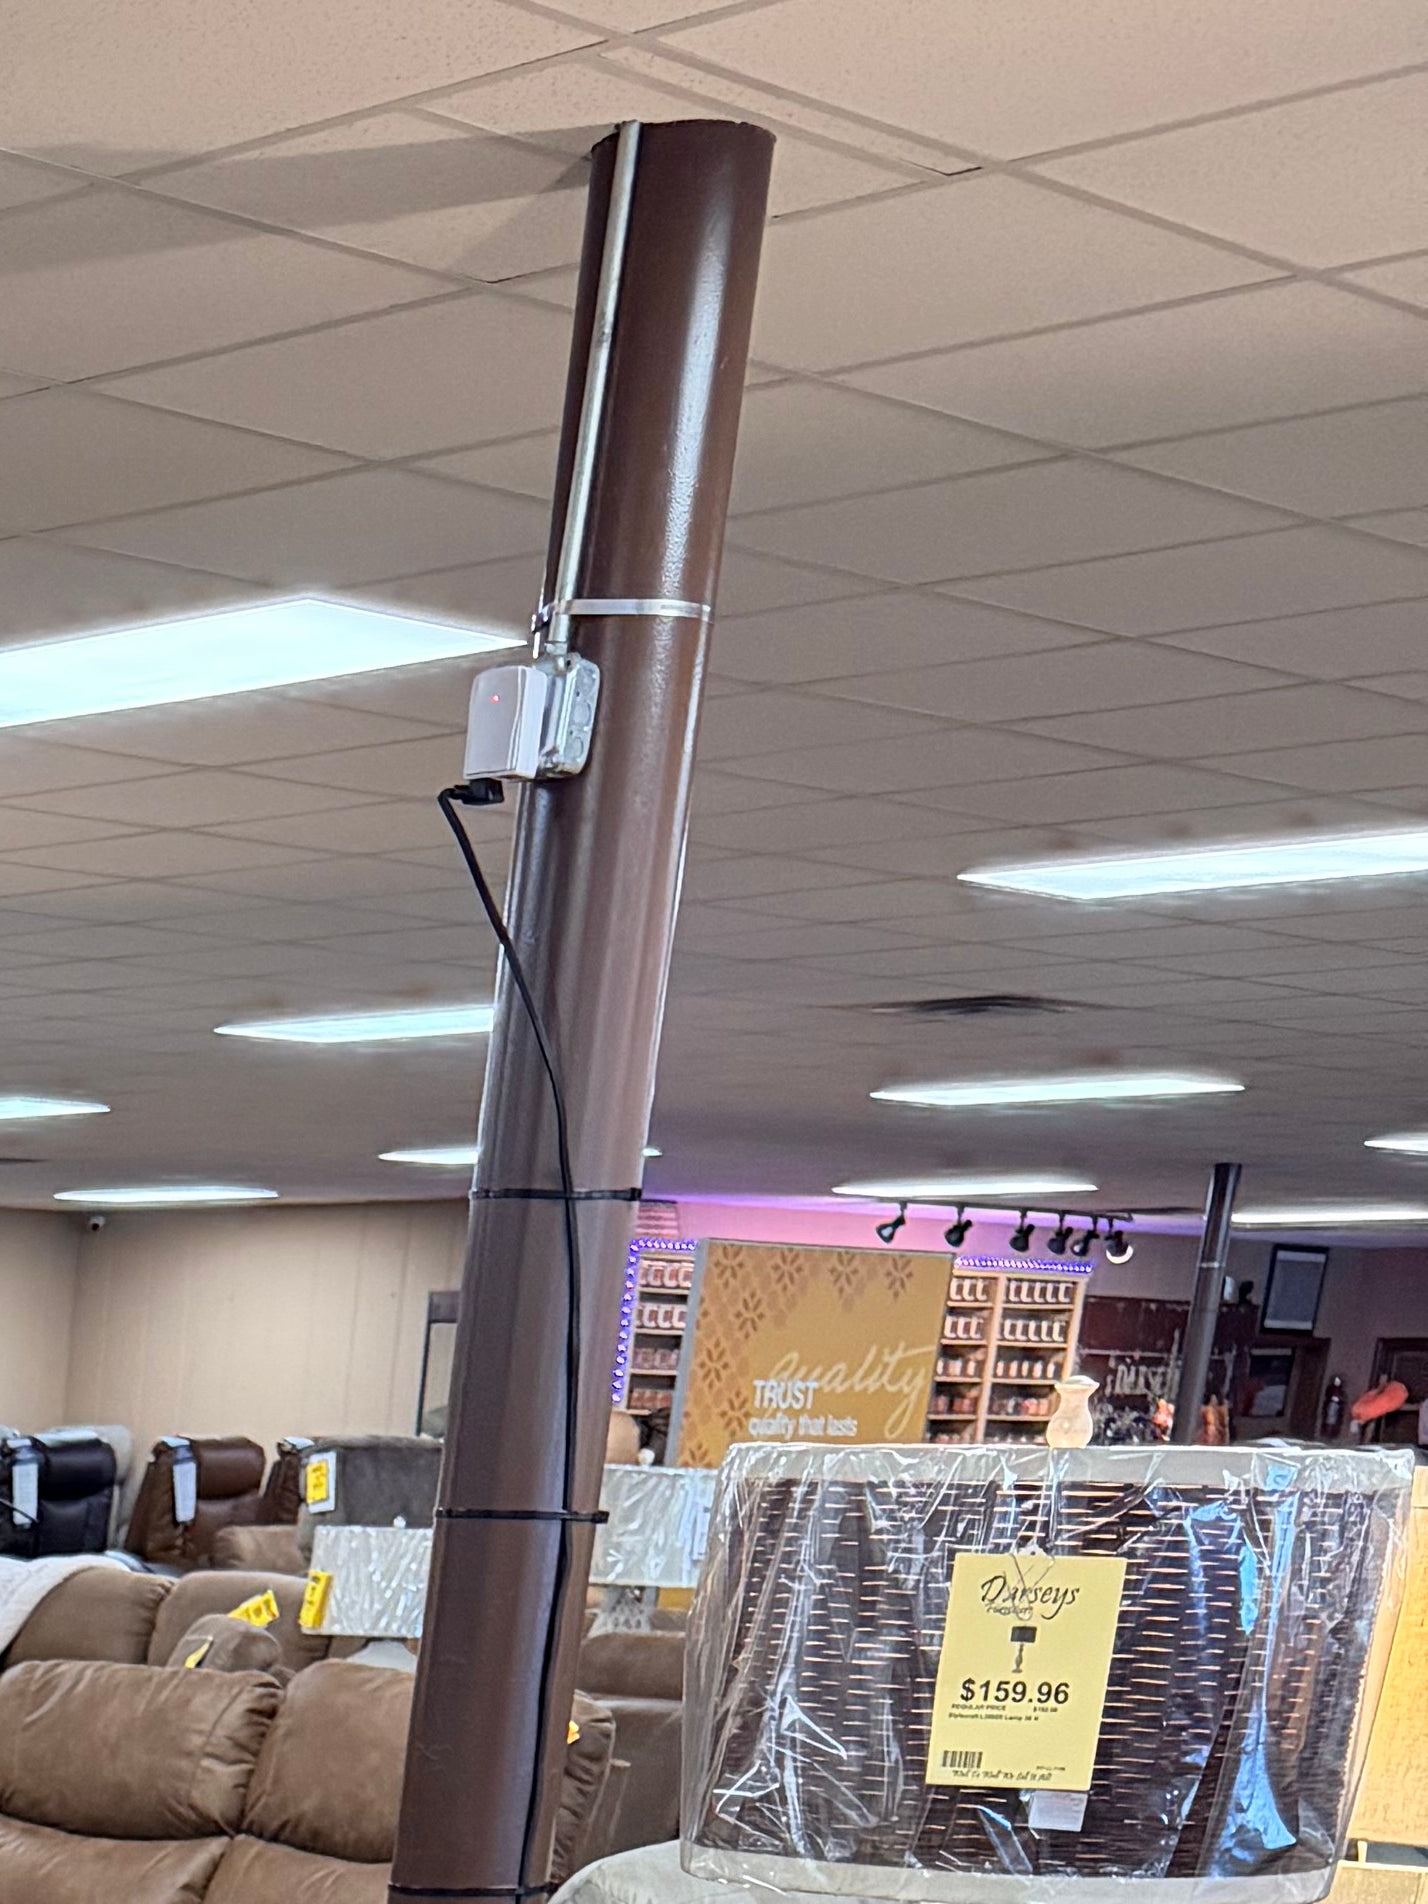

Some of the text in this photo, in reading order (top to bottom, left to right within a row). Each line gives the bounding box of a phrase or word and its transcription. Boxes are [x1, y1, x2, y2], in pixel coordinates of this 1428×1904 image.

[752, 1379, 818, 1409] TRUST
[981, 1575, 1080, 1620] Darseys
[960, 1677, 1070, 1704] $159.96
